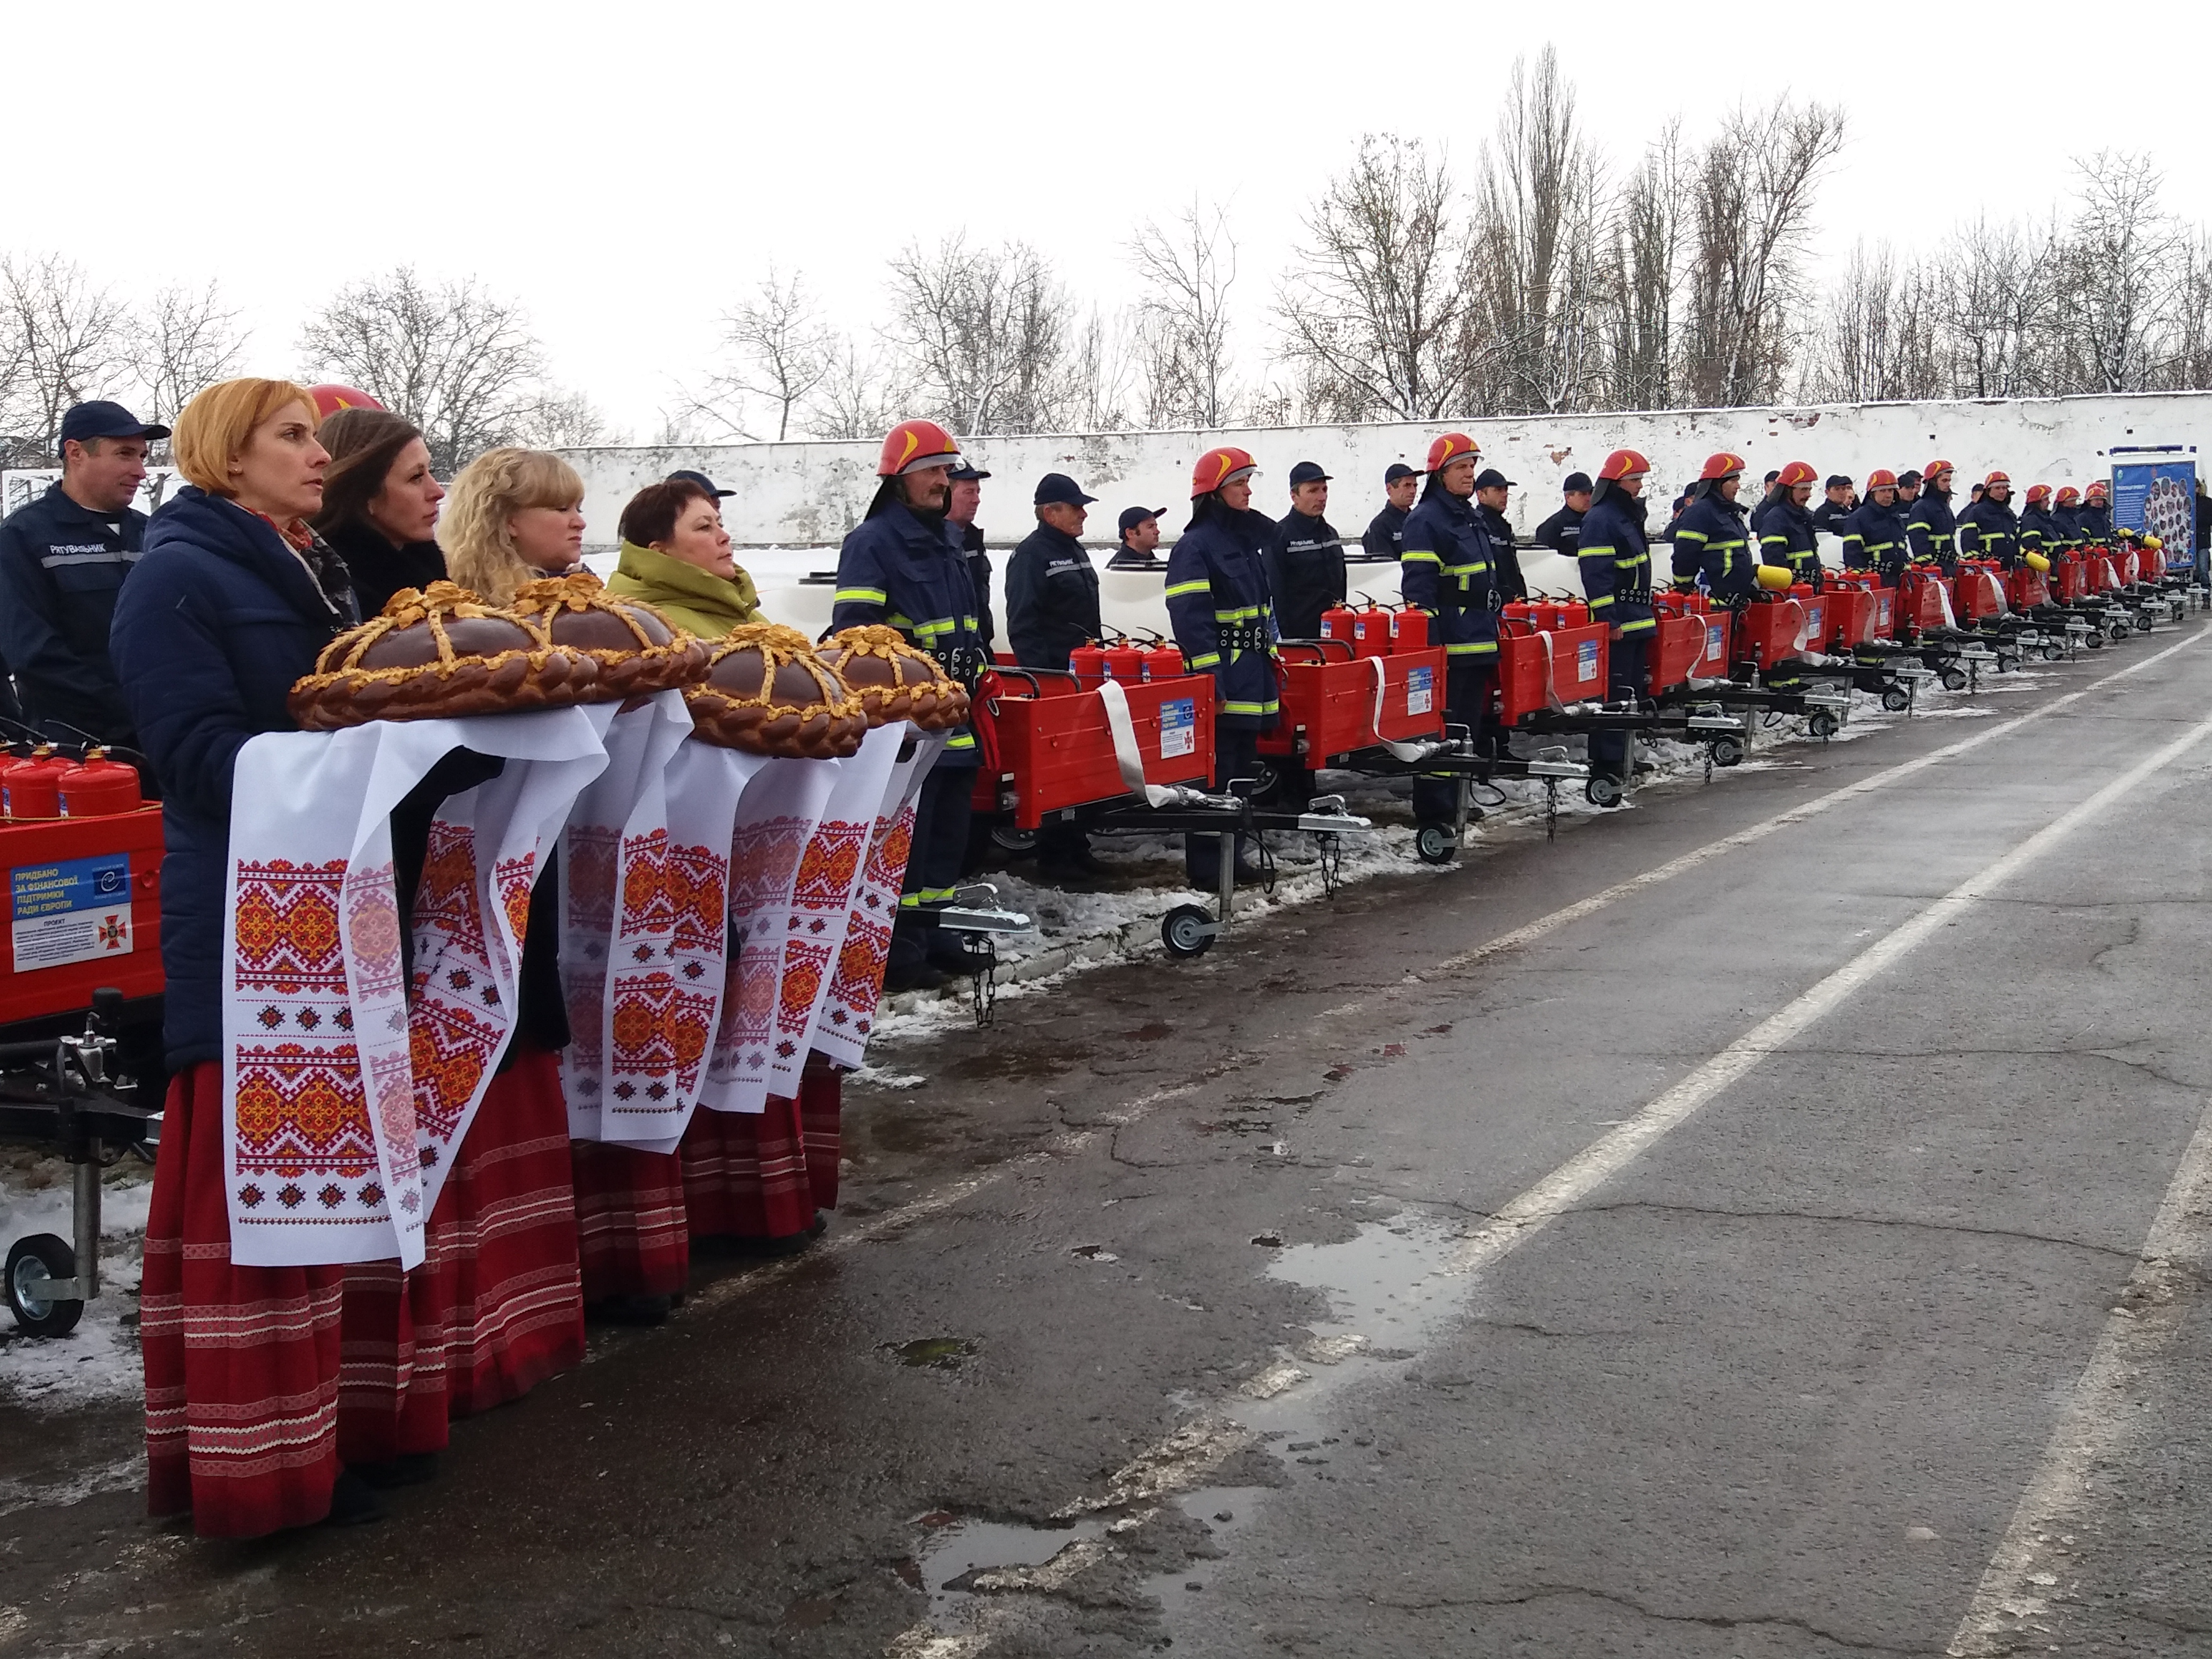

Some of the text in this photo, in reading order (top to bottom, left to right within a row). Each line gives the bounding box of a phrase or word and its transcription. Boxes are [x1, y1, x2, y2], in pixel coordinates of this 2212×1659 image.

[50, 543, 106, 554] РЯТУВАЛЬНИК
[16, 868, 58, 881] ПРИДБАНО
[16, 876, 78, 893] ЗА ФІНАНСОВОЇ
[17, 890, 64, 904] ПІДТРИМКИ
[17, 900, 72, 915] РАДИ ЄВРОПИ
[44, 918, 65, 926] ПРОЕКТ
